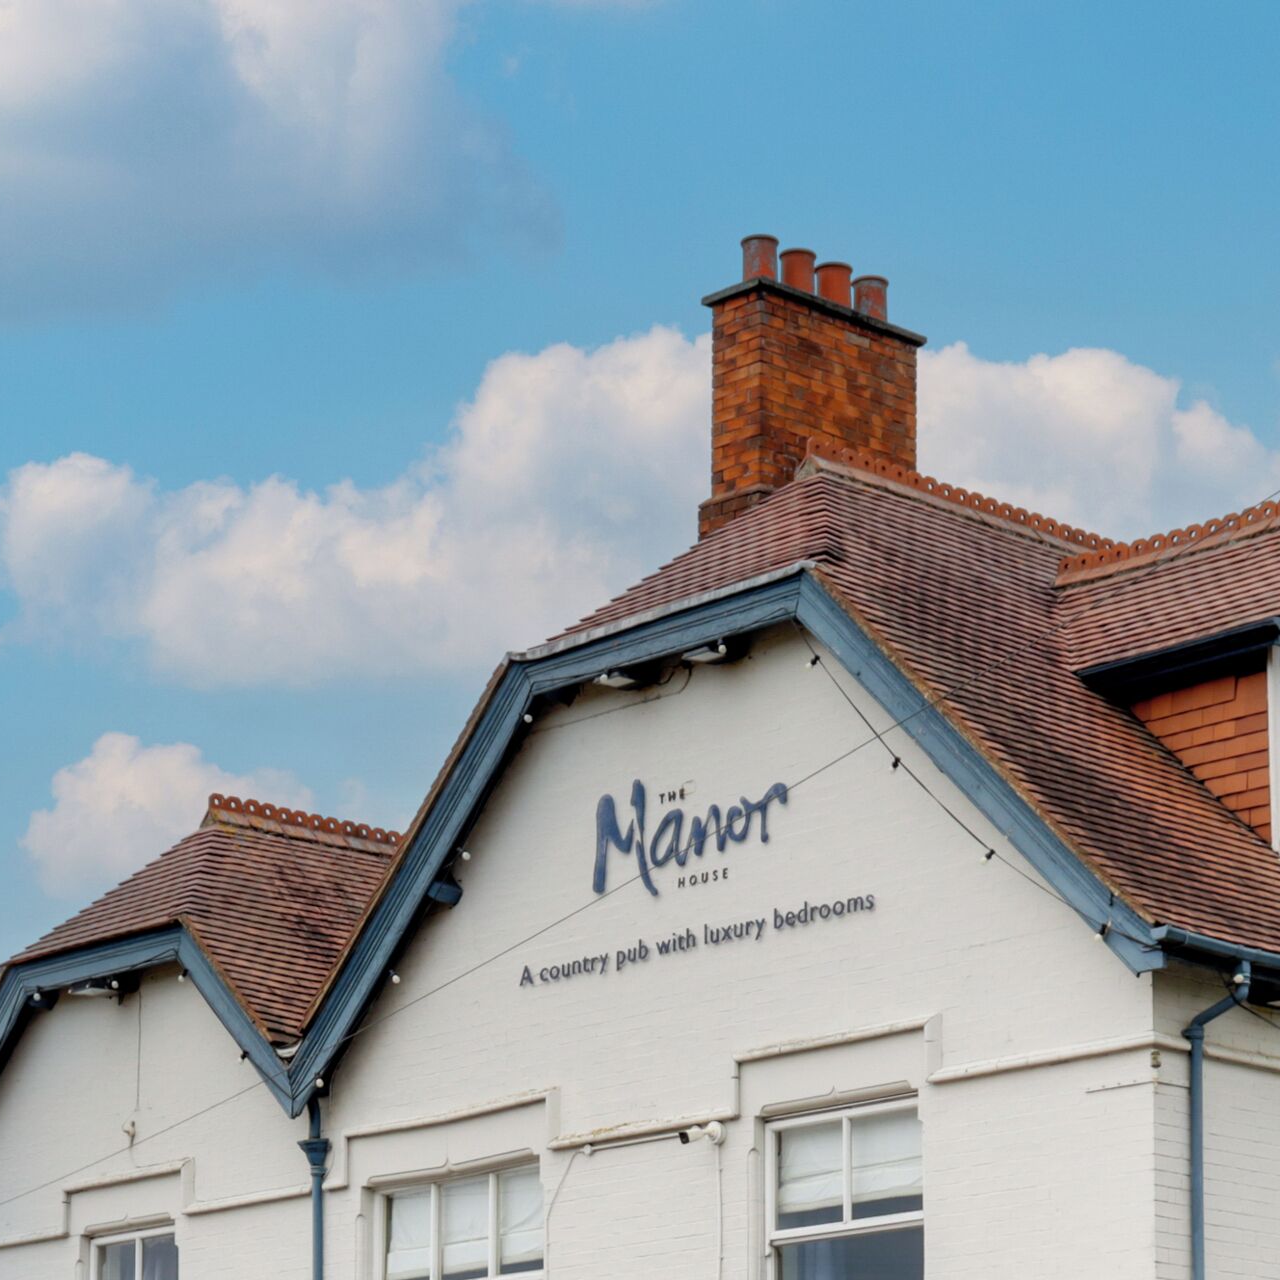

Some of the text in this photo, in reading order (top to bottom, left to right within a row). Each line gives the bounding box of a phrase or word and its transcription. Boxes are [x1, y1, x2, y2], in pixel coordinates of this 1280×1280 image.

[659, 788, 686, 804] THE
[592, 779, 788, 897] Manor
[676, 867, 730, 889] HOUSE
[520, 893, 875, 986] A country pub with luxury bedrooms
